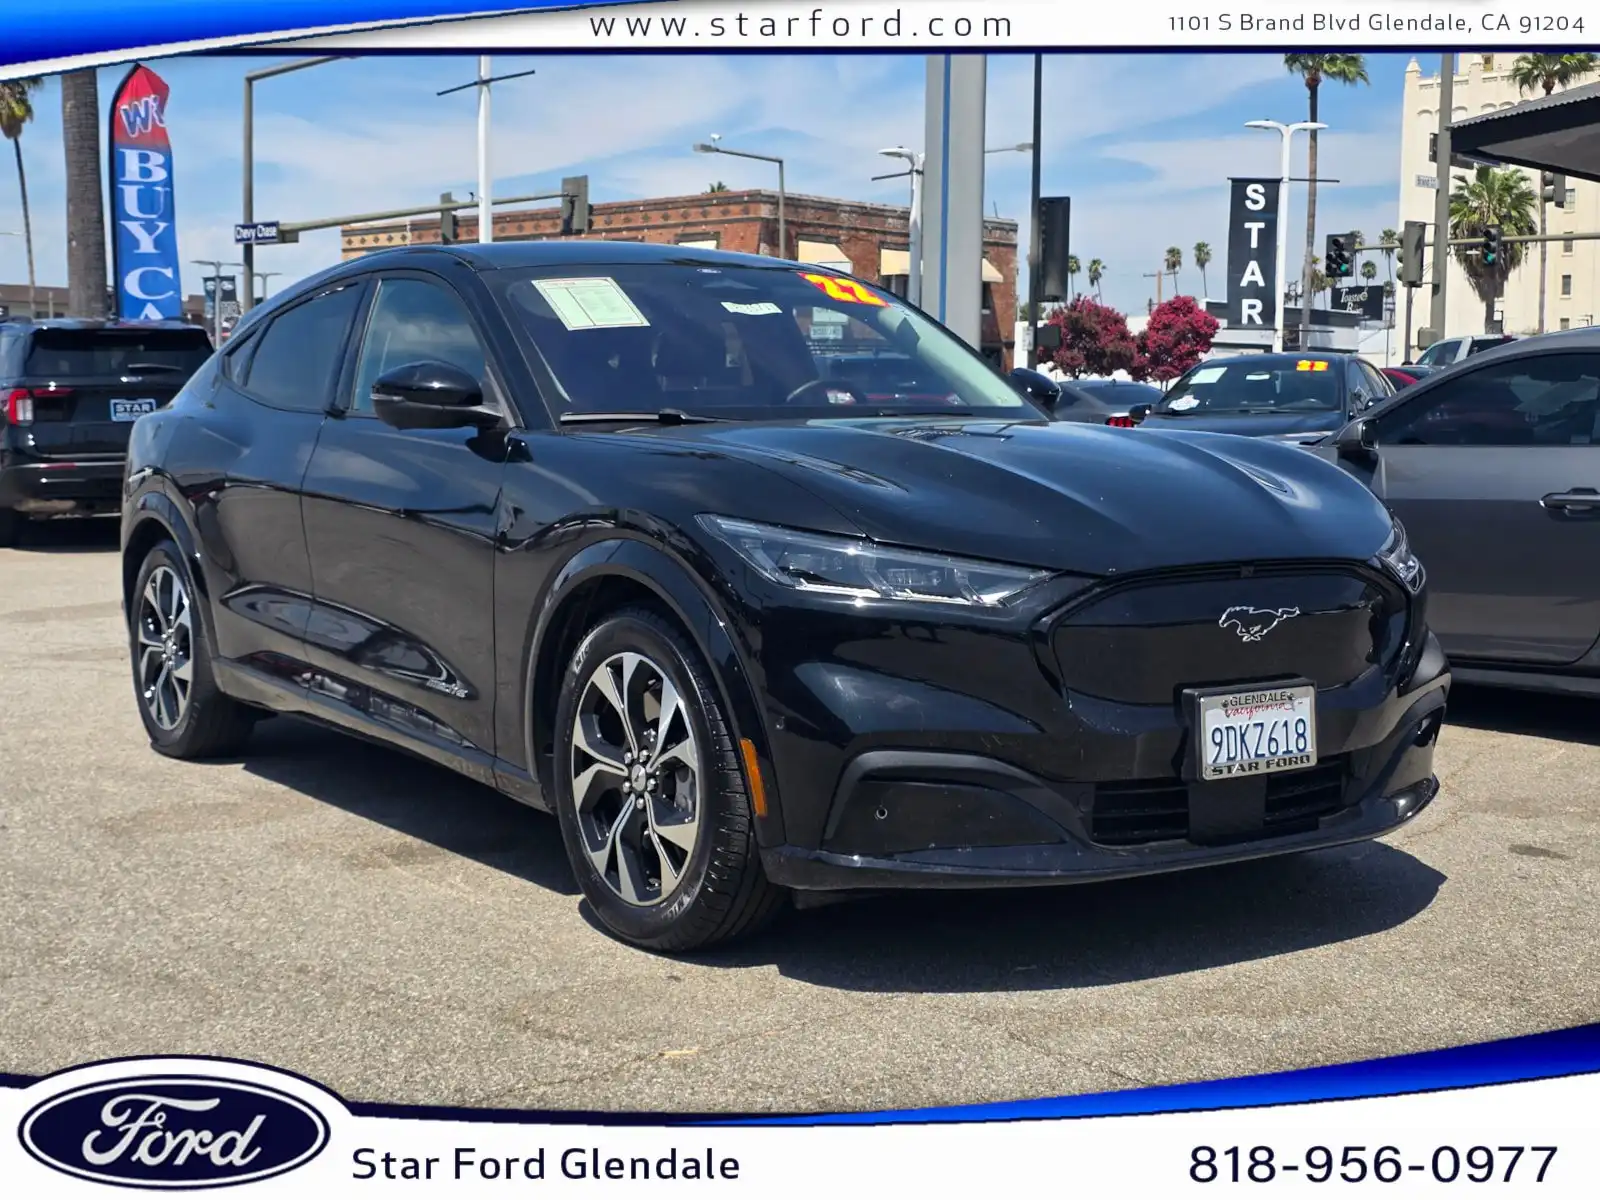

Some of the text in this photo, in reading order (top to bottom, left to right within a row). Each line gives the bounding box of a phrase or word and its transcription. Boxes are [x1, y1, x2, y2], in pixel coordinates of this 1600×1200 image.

[118, 148, 171, 254] BUY
[236, 224, 277, 241] Chevy Chase
[1240, 183, 1266, 325] STAR
[115, 403, 151, 412] STAR
[1230, 691, 1287, 707] GLENDALE
[1211, 717, 1307, 764] 9DKZ618
[1211, 755, 1311, 776] STAR FORD
